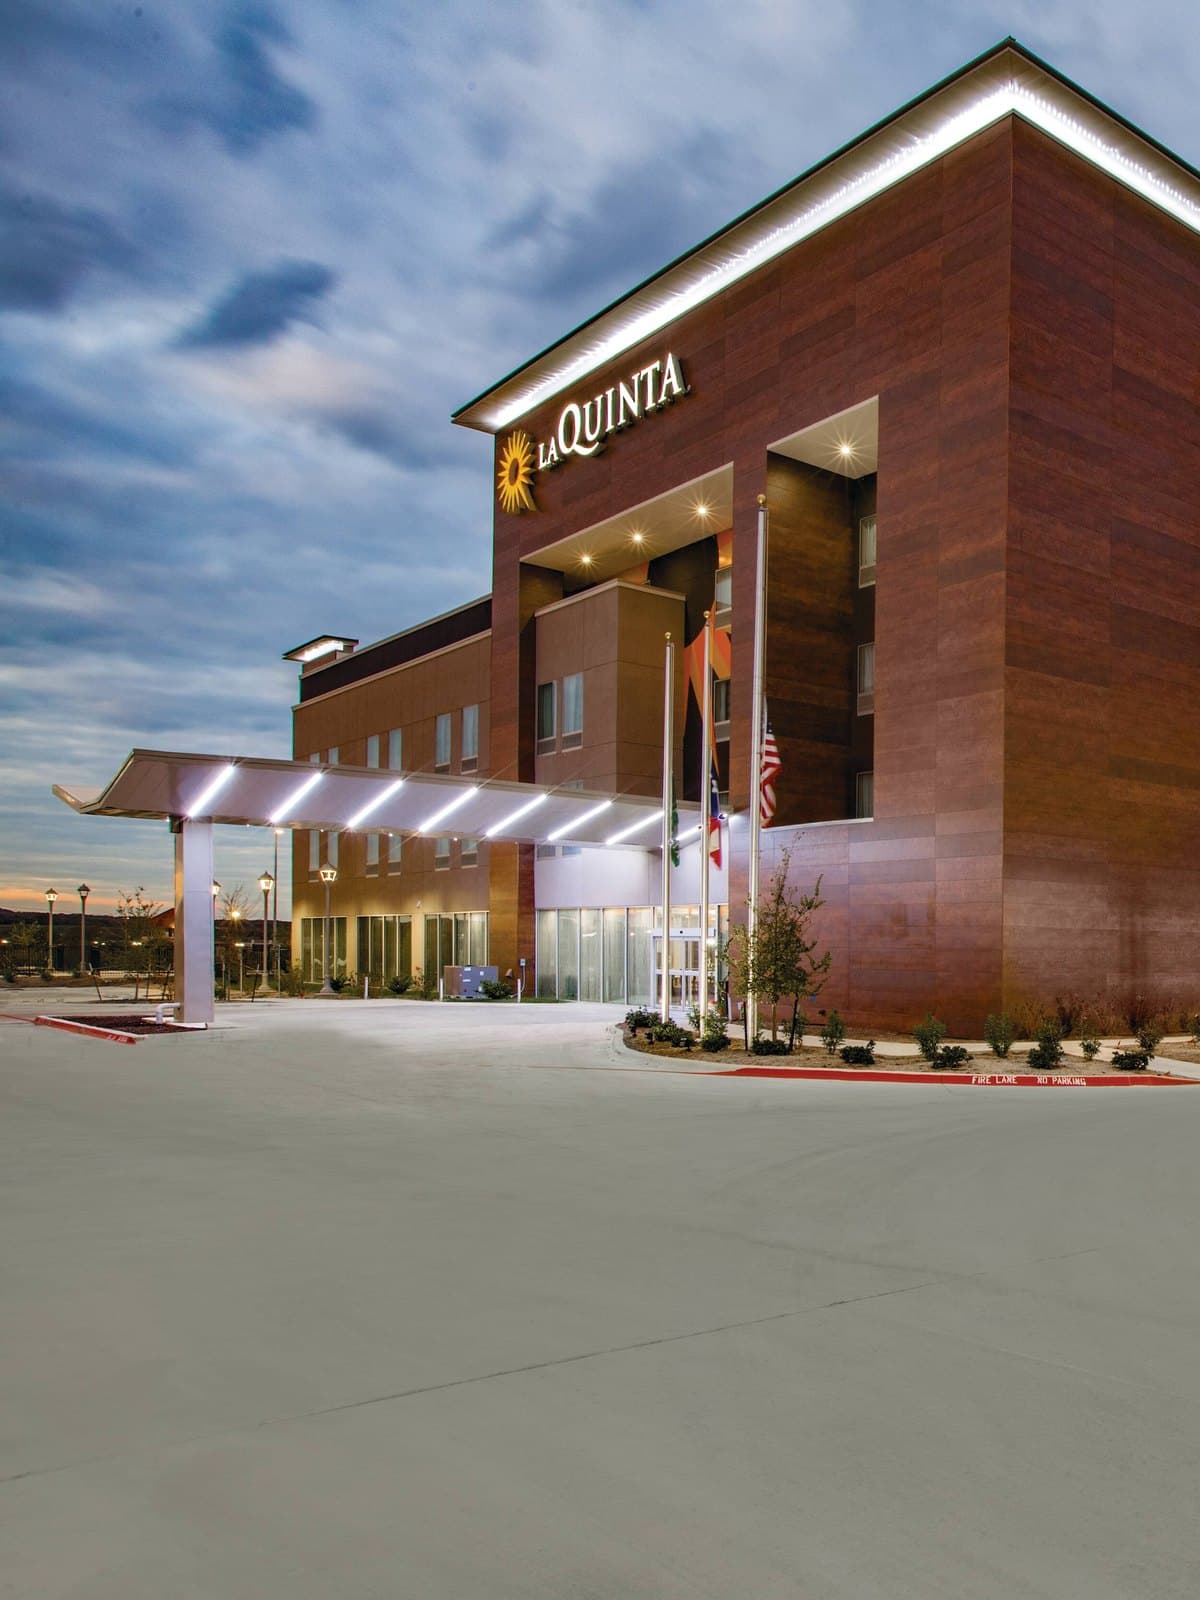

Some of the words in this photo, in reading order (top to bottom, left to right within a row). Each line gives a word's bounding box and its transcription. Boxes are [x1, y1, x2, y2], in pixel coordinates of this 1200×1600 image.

[537, 436, 560, 469] LA
[558, 352, 684, 456] QUINTA
[971, 1075, 992, 1084] FIRE
[995, 1075, 1018, 1084] LANE
[1037, 1076, 1048, 1085] NO
[1052, 1076, 1087, 1086] PARKING
